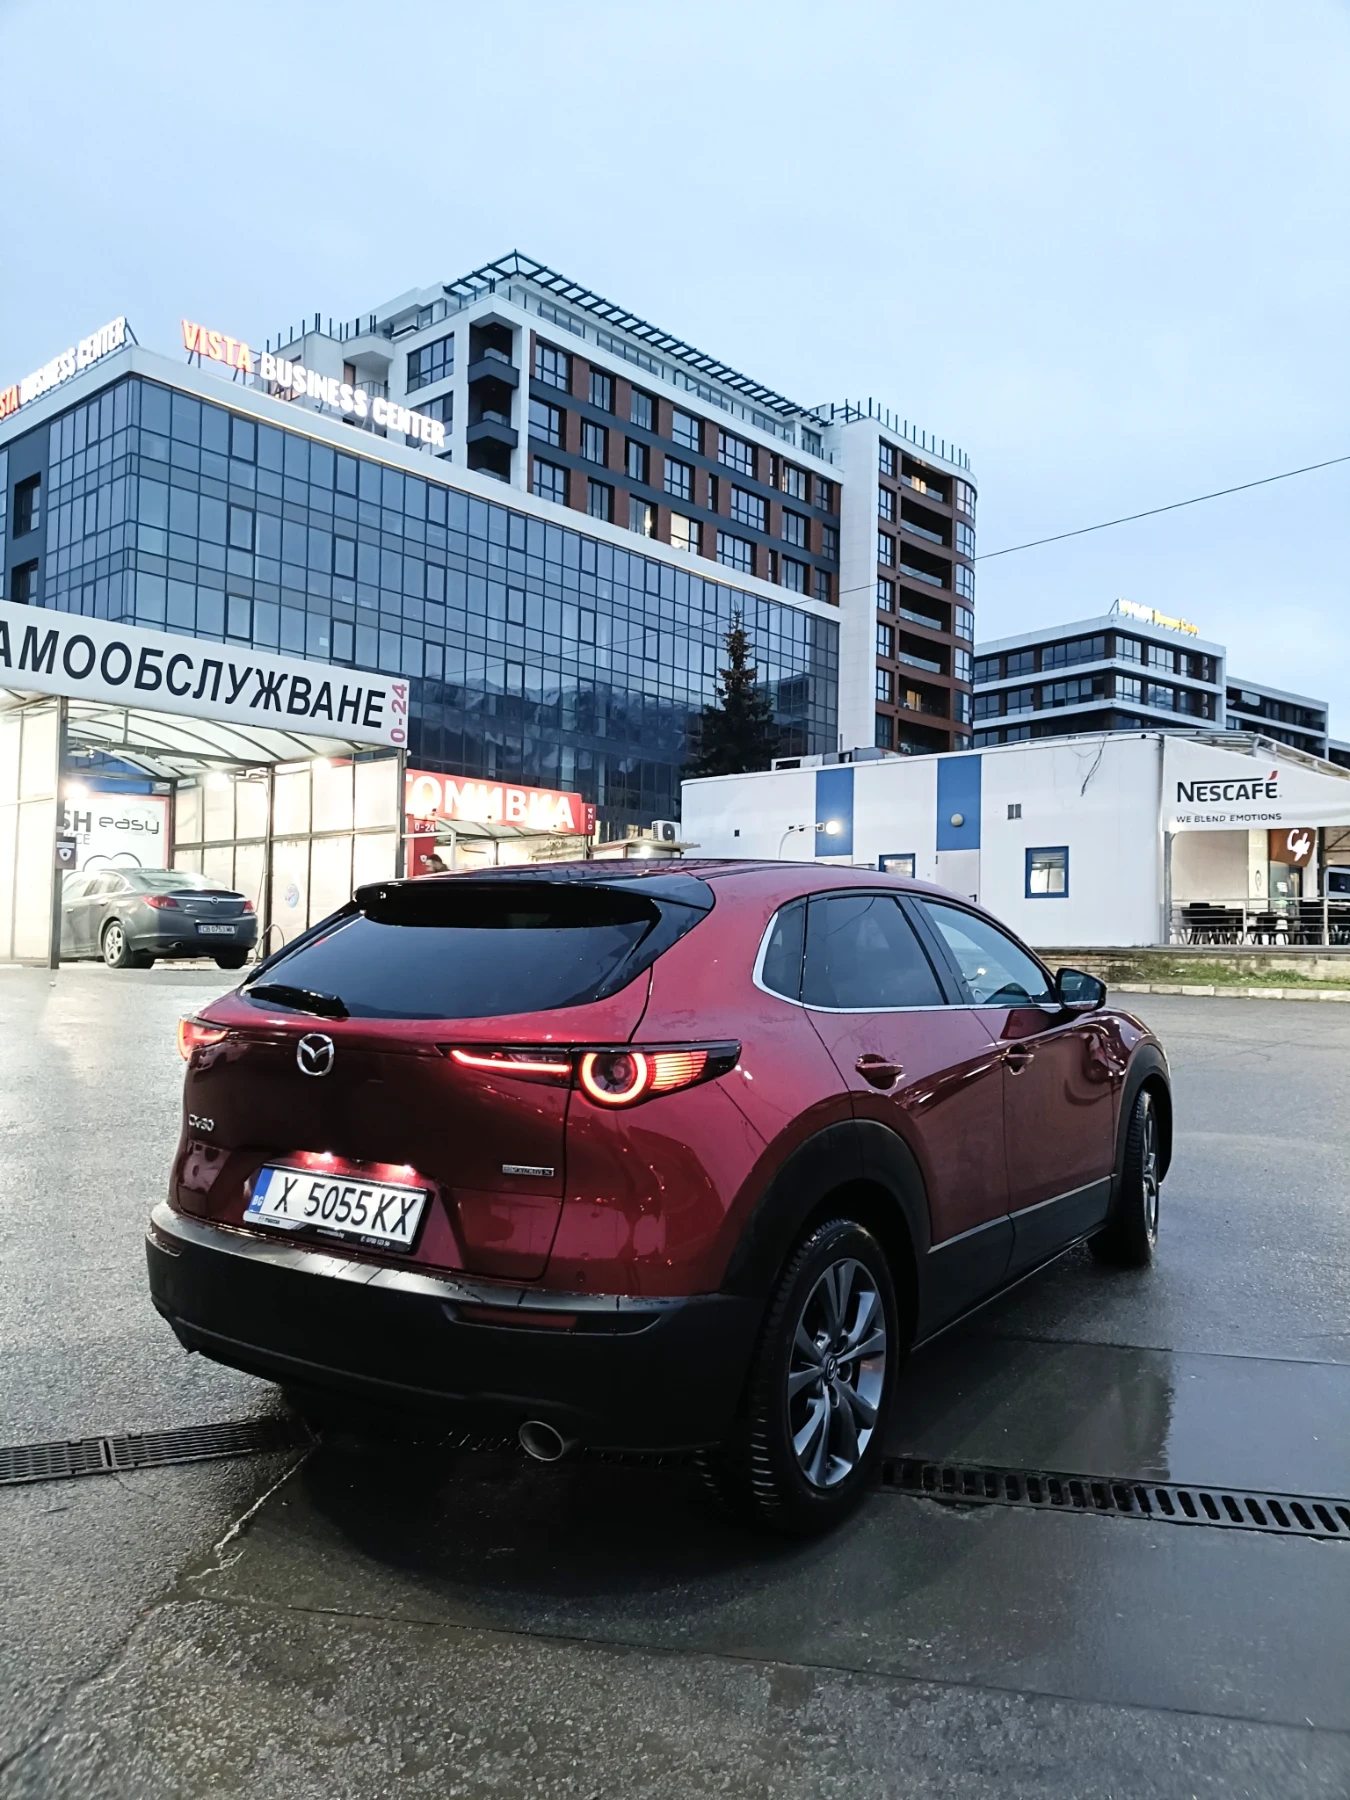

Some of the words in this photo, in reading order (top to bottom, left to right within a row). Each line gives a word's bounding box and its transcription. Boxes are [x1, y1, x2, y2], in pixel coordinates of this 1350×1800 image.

[182, 319, 252, 373] VISTA
[260, 351, 368, 417] BUSINESS
[372, 397, 445, 448] CENTER
[391, 684, 407, 743] 0-24
[1177, 770, 1278, 803] NESCAFÉ
[98, 816, 160, 834] easy
[414, 822, 435, 832] 0-24
[1229, 813, 1282, 822] EMOTIONS
[252, 1195, 264, 1206] BG
[274, 1176, 298, 1212] X
